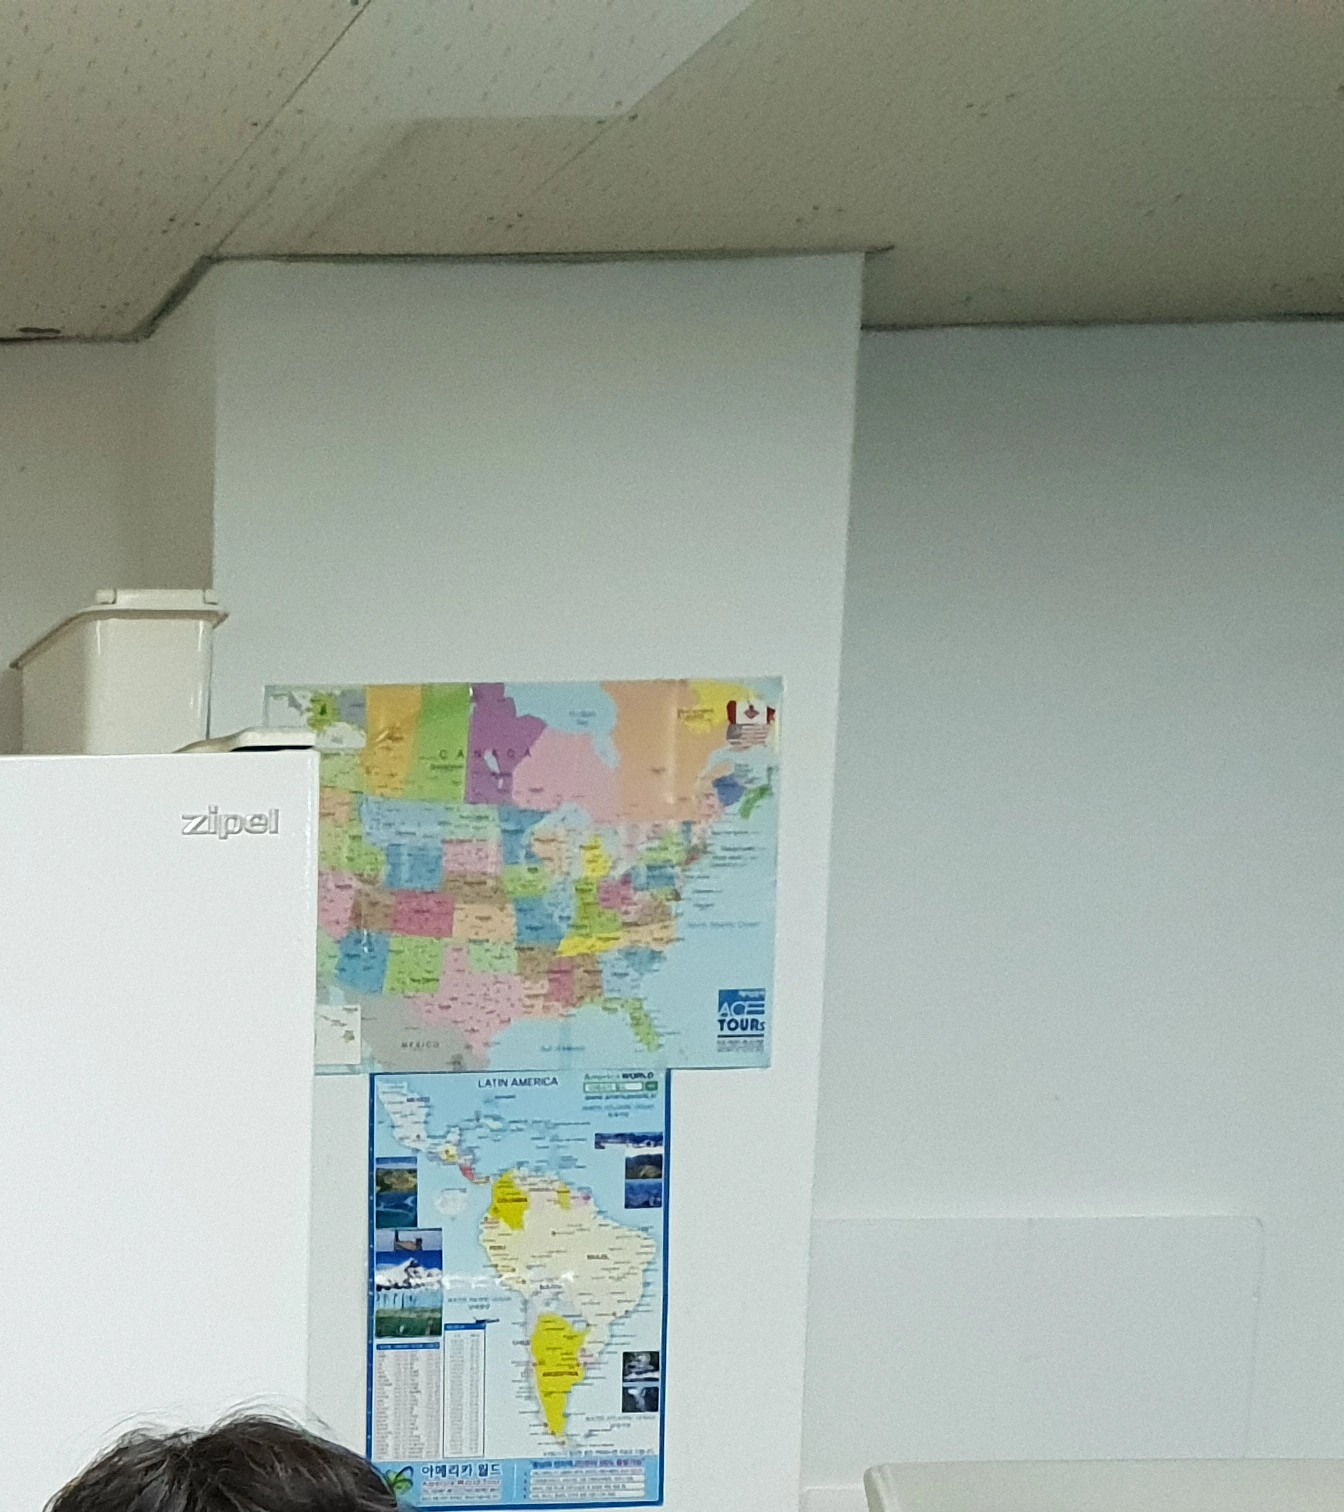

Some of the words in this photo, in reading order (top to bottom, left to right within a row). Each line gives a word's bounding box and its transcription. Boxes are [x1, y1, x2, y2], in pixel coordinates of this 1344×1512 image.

[181, 804, 280, 839] zipel
[718, 1001, 765, 1017] ACE
[478, 1078, 508, 1089] LATIN
[511, 1076, 559, 1087] AMERICA
[421, 1463, 473, 1478] 아메리카
